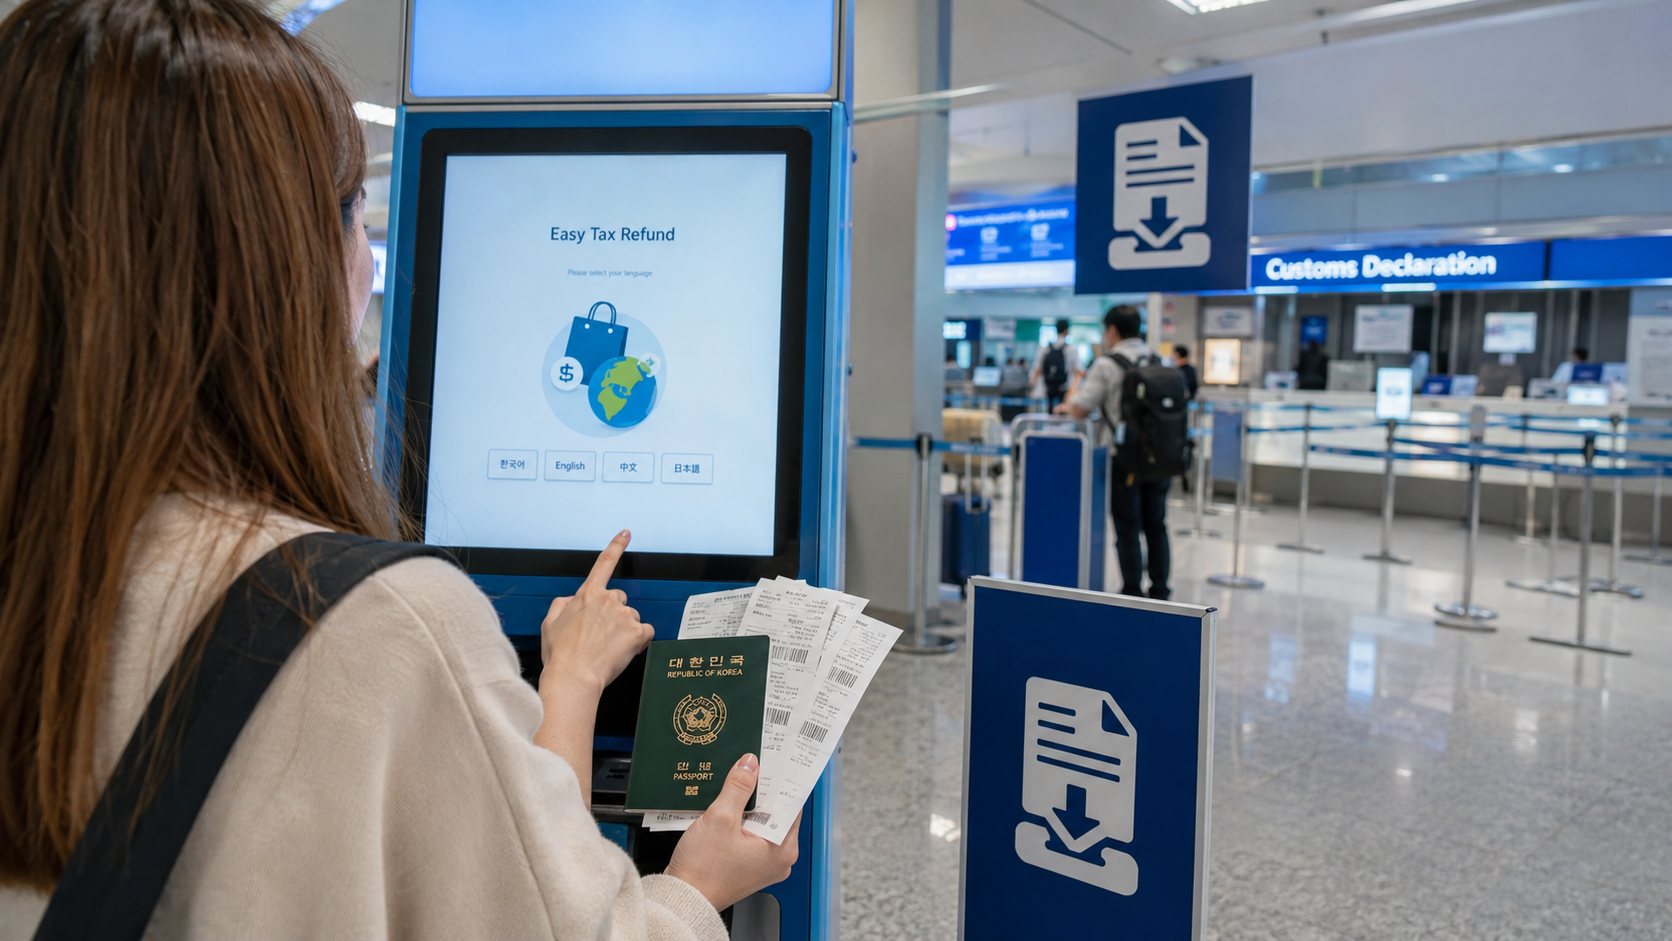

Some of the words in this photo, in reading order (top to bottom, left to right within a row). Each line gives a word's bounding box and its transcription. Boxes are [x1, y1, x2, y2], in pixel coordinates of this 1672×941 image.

[550, 226, 586, 245] Easy
[590, 226, 616, 241] Tax
[621, 226, 676, 241] Refund
[1265, 257, 1359, 281] Customs
[1362, 250, 1497, 279] Declaration
[567, 268, 588, 277] Please
[589, 269, 607, 277] select
[608, 270, 623, 278] your
[624, 269, 653, 279] language
[500, 459, 525, 470] 한국어
[555, 460, 585, 472] English
[620, 462, 638, 472] 中文
[674, 464, 700, 474] 日本語
[667, 670, 704, 678] REPUBLIC
[704, 669, 715, 677] OF
[716, 668, 743, 676] KOREA
[673, 772, 714, 781] PASSPORT
